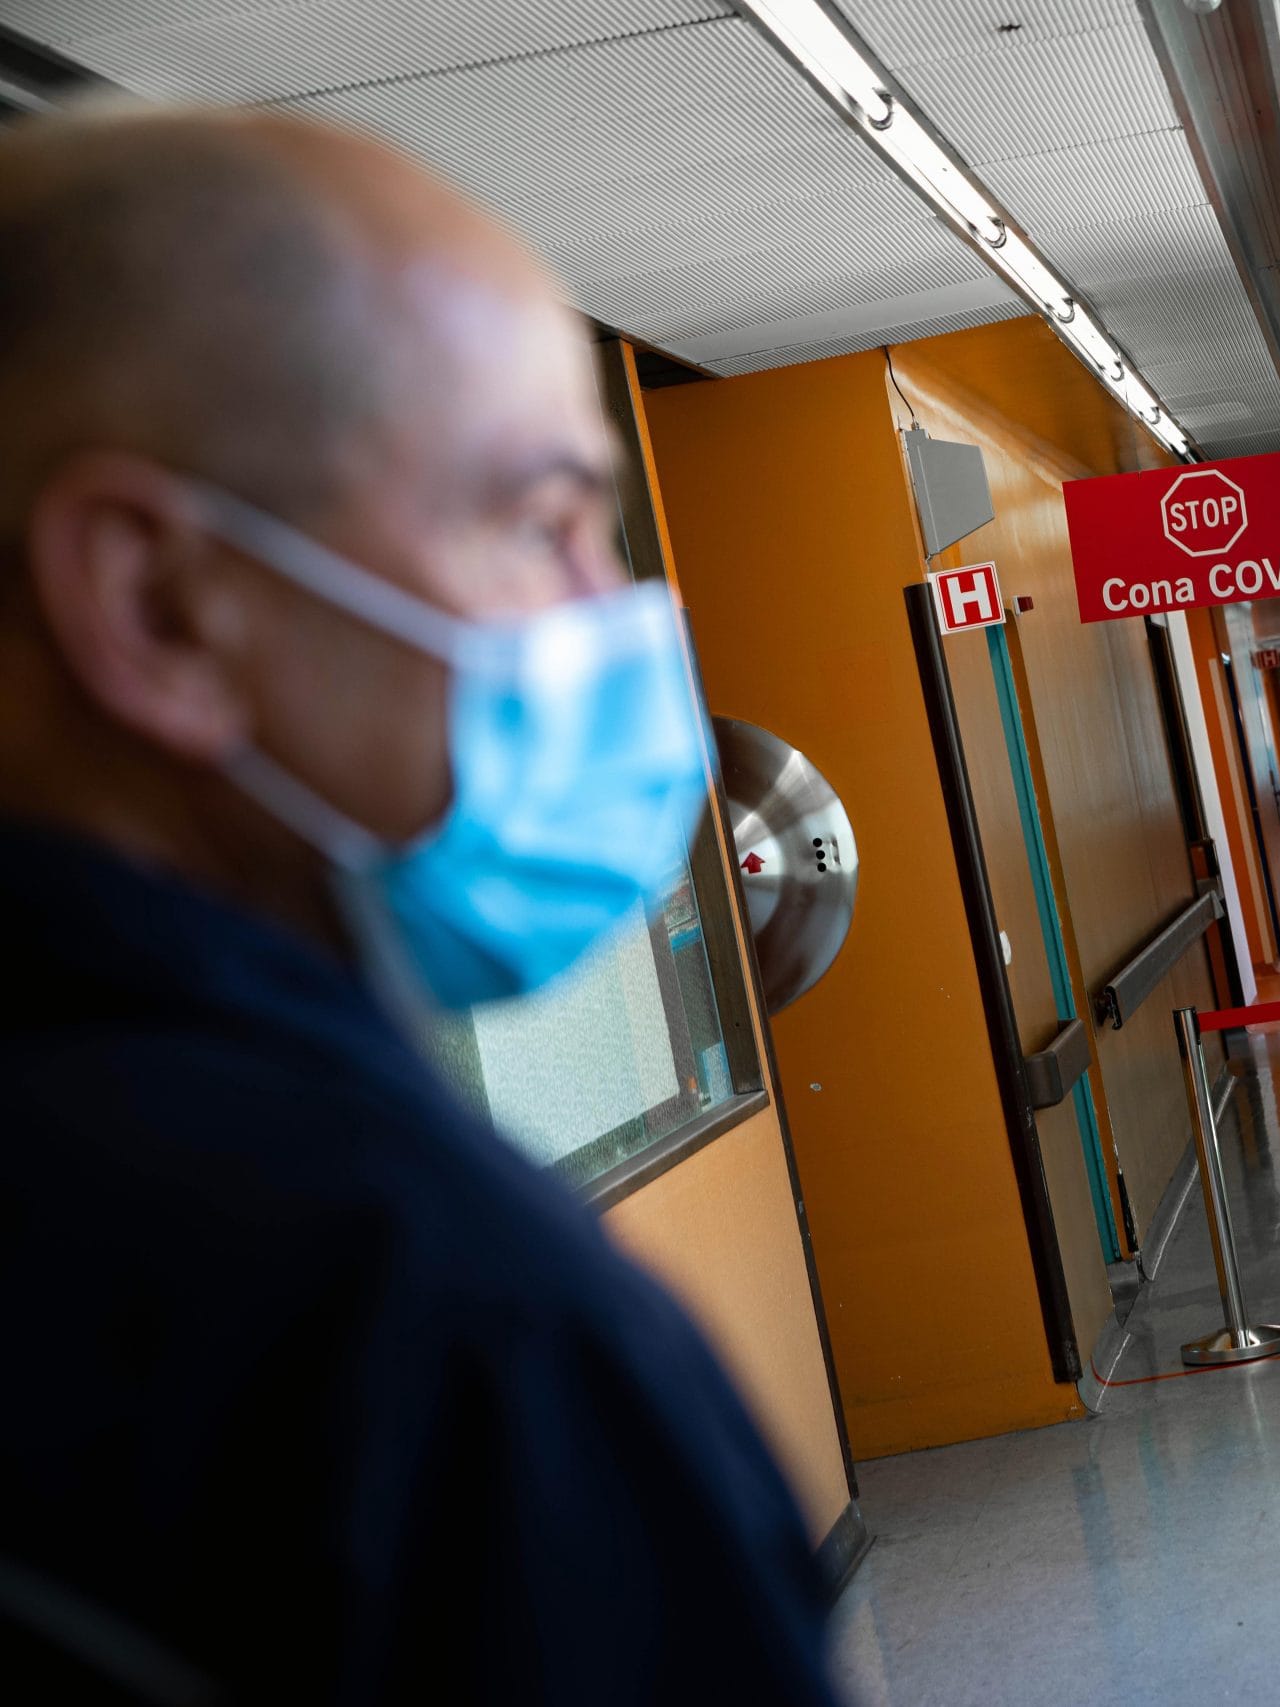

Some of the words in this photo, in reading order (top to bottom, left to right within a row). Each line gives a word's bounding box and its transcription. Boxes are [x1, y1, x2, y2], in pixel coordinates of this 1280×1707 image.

[1170, 496, 1238, 533] STOP
[946, 572, 993, 625] H
[1102, 577, 1195, 612] Cona
[1263, 652, 1277, 667] H
